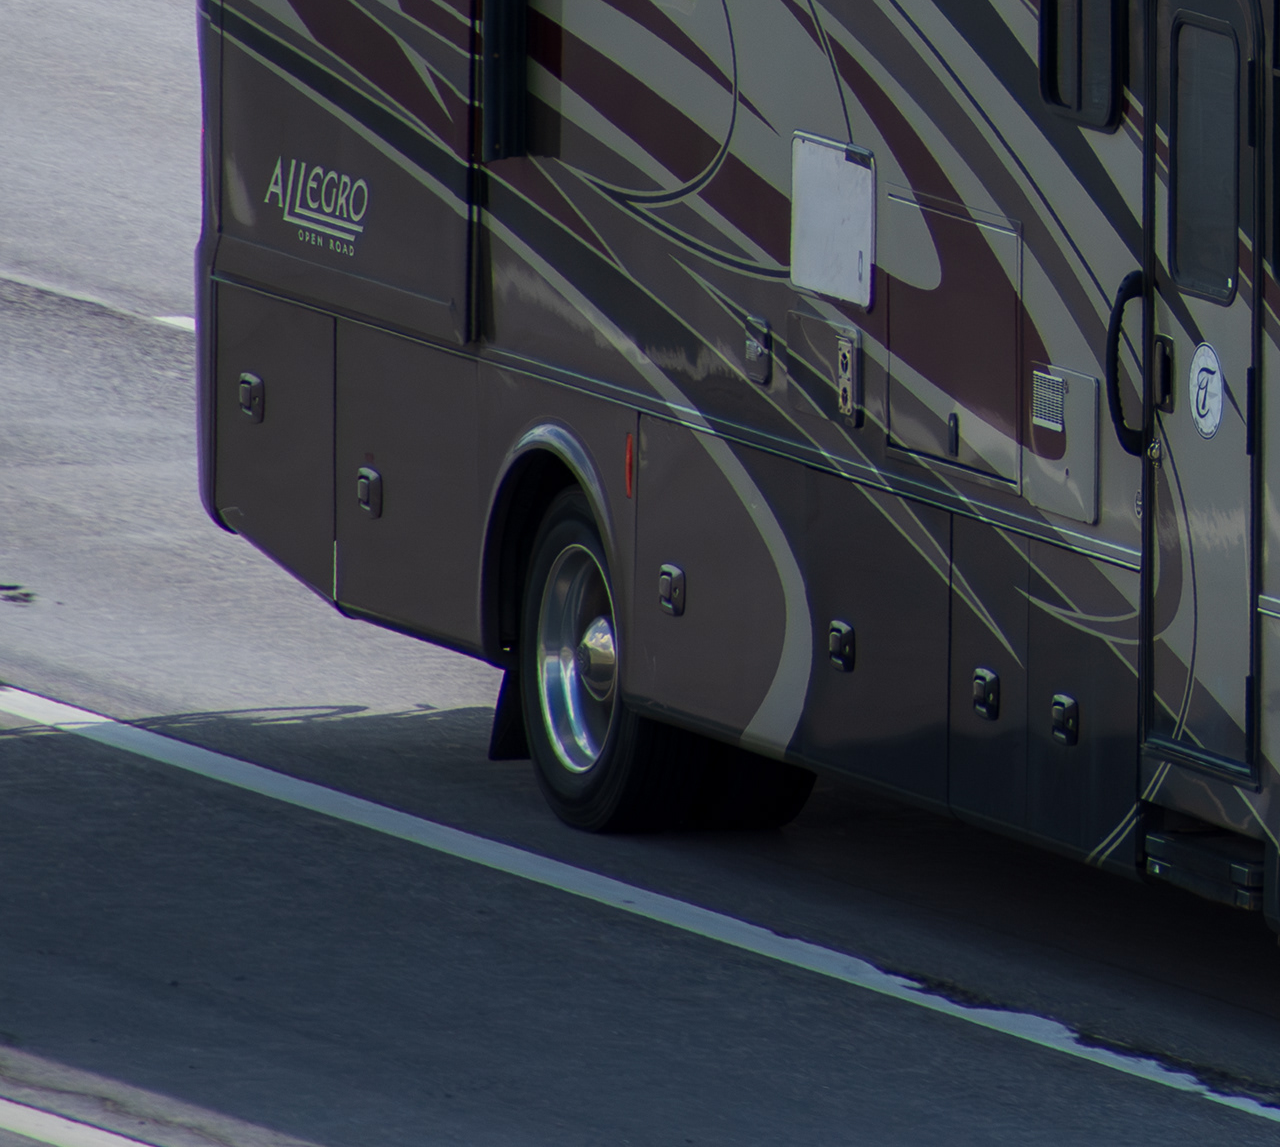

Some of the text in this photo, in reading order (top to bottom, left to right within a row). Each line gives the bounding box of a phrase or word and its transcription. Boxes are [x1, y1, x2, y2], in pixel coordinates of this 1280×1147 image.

[263, 155, 368, 241] ALLEGRO
[298, 229, 355, 257] OPEN ROAD
